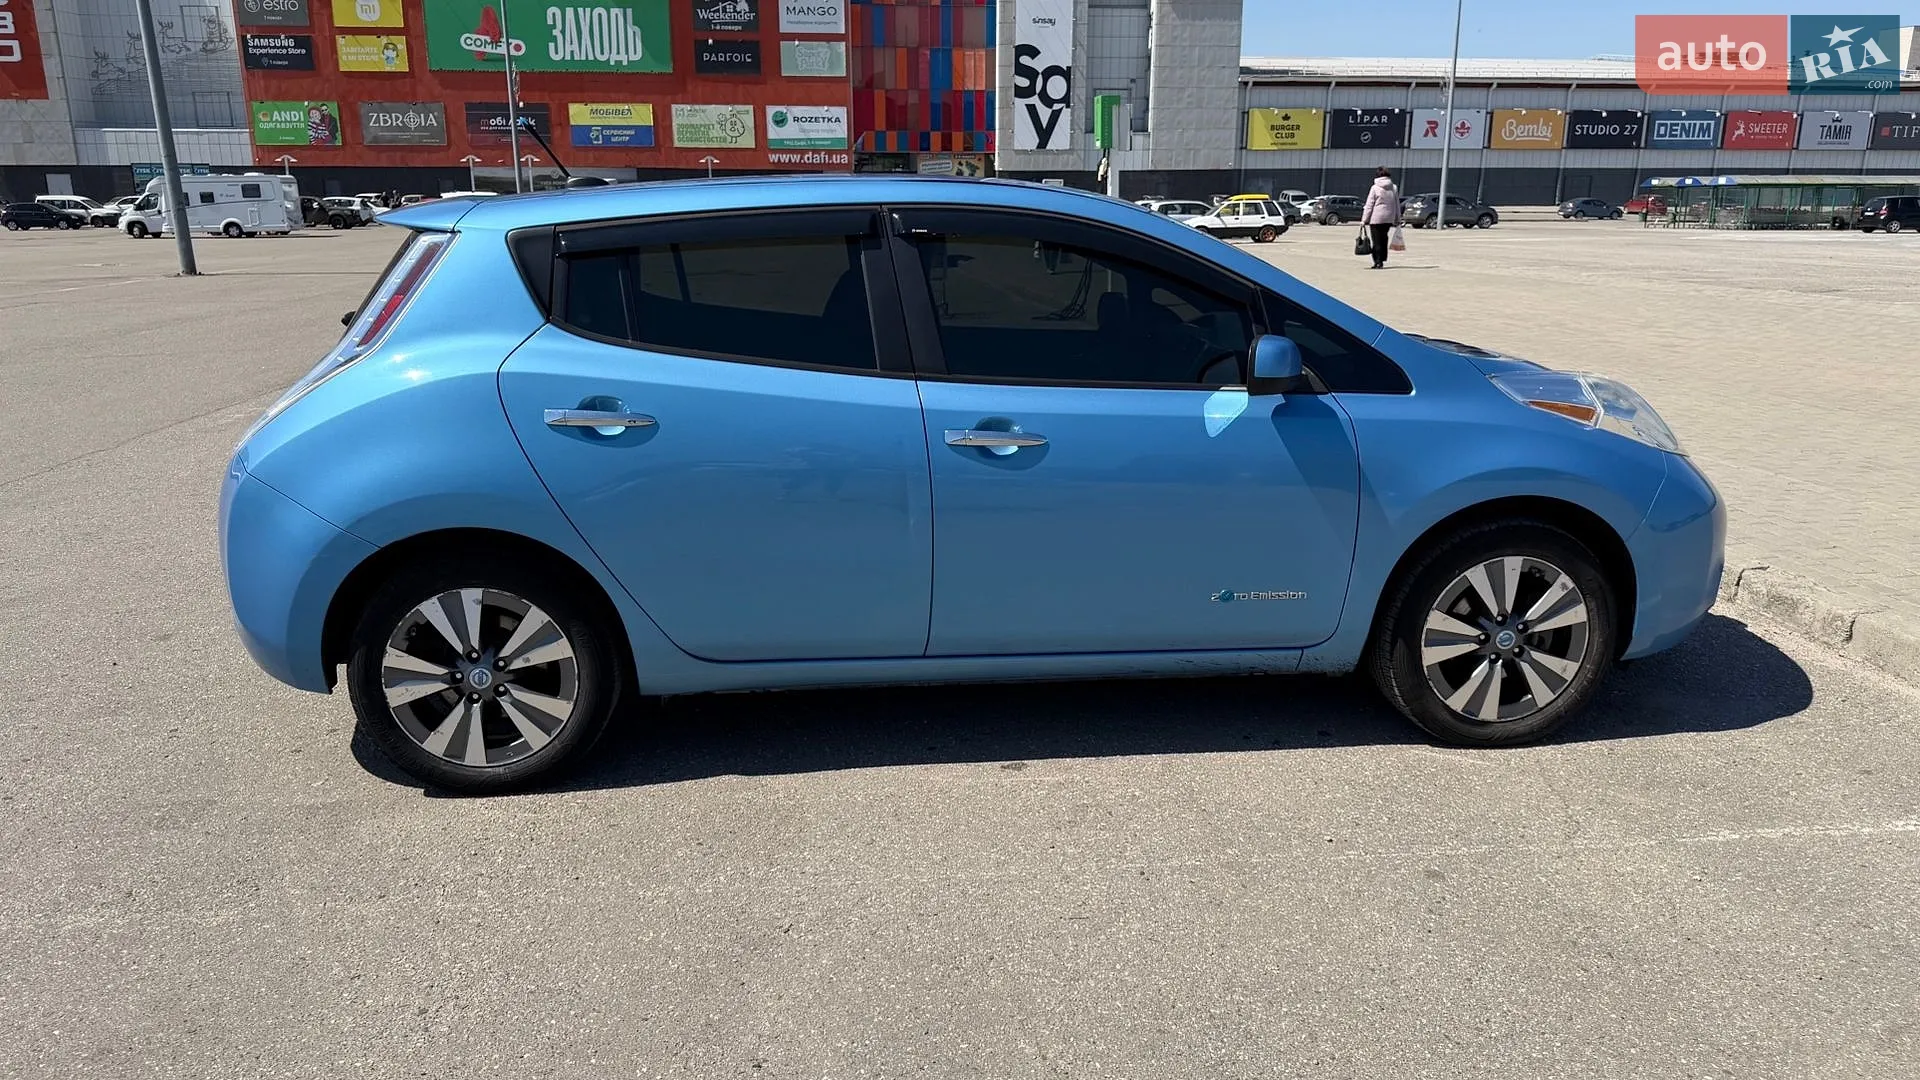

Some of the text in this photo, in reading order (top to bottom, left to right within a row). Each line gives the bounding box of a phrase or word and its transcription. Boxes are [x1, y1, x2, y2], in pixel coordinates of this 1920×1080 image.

[696, 7, 756, 20] Weekender
[786, 6, 837, 16] MANGO
[1032, 16, 1056, 26] sinsay
[546, 6, 643, 65] ЗАХОДЬ
[247, 38, 295, 47] SAMSUNG
[248, 47, 306, 55] Experience Store
[272, 111, 304, 121] ANDI
[1348, 115, 1388, 123] LIPAR
[1501, 118, 1553, 141] Bembi
[1574, 124, 1638, 136] STUDIO 27
[1655, 121, 1714, 139] DENIM
[1748, 122, 1788, 134] SWEETER
[1819, 124, 1852, 140] TAMIR
[768, 152, 849, 164] www.dafi.ua
